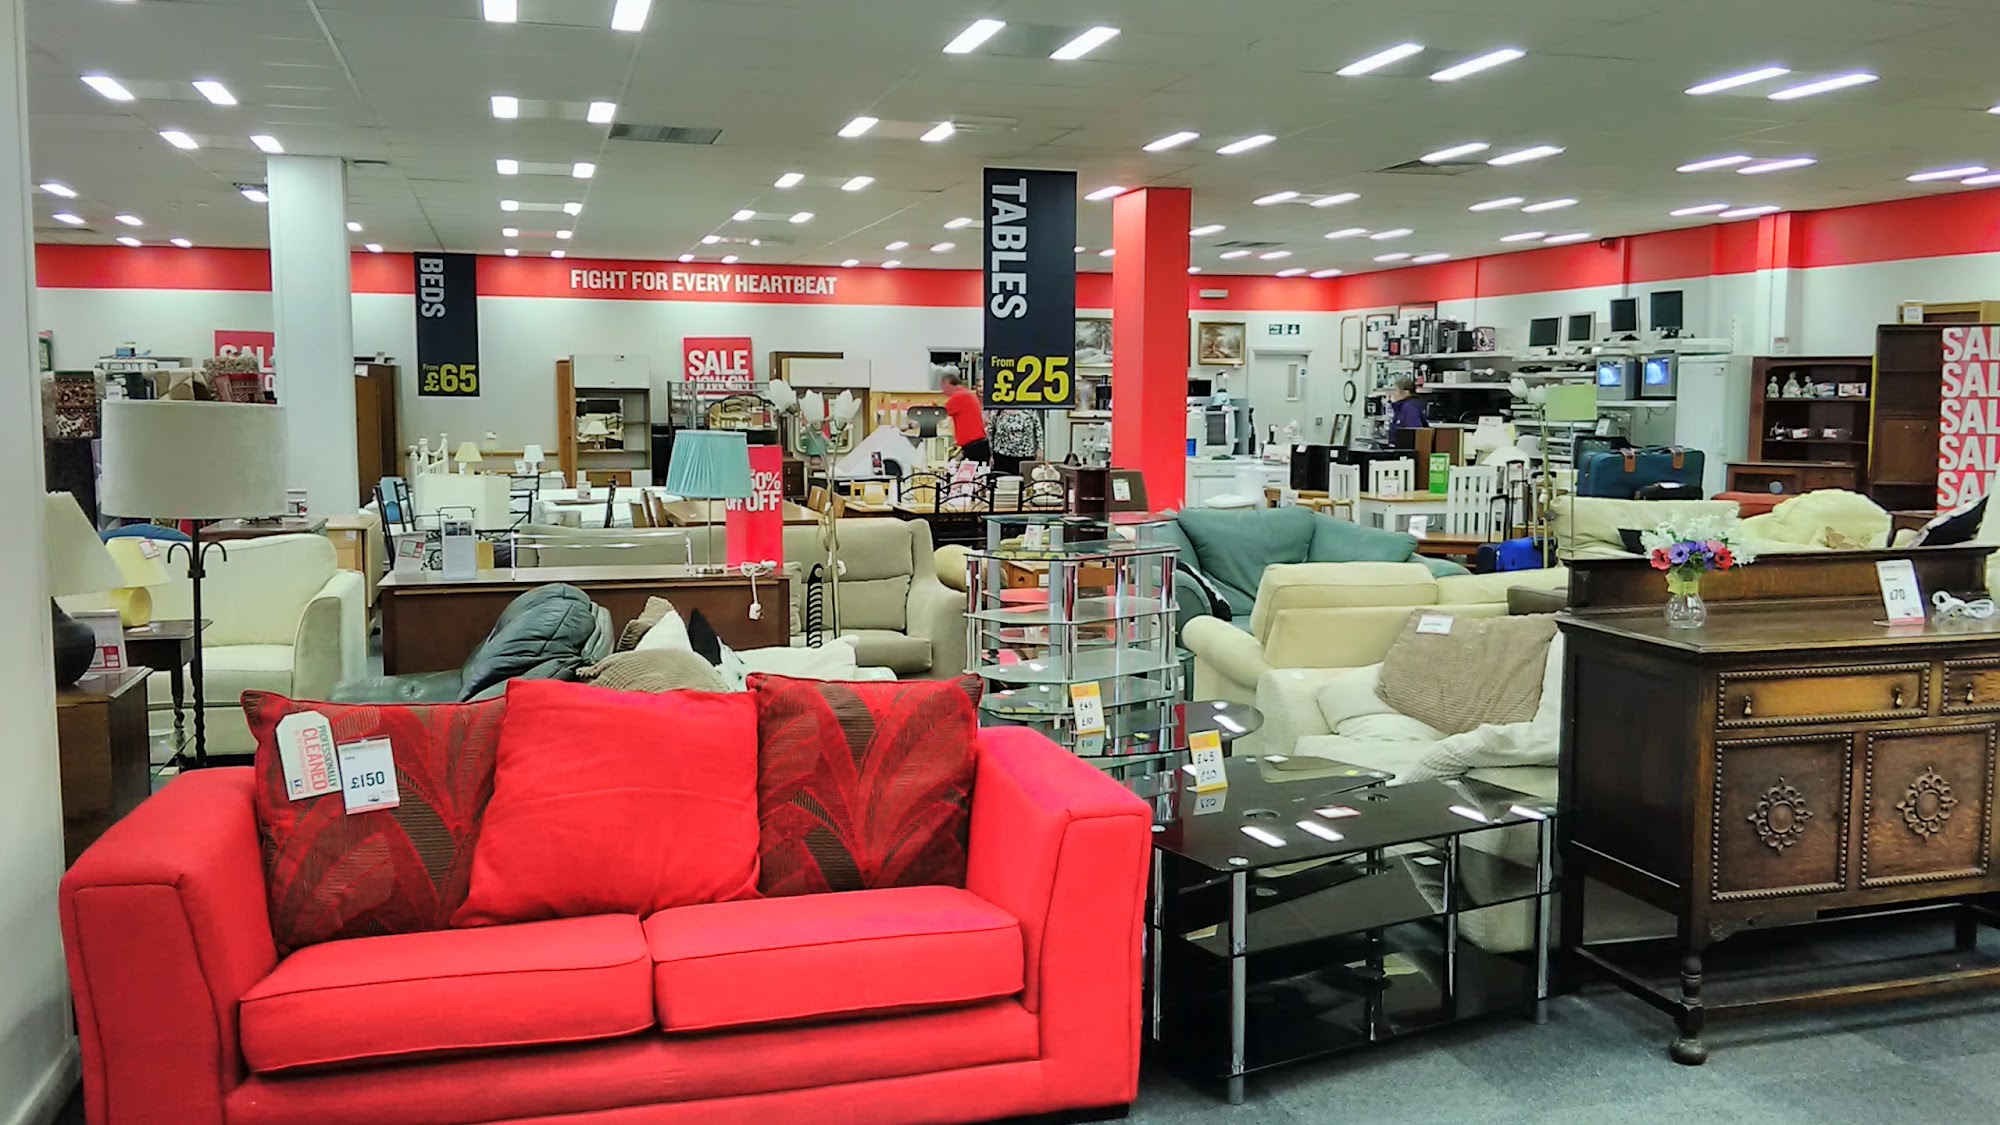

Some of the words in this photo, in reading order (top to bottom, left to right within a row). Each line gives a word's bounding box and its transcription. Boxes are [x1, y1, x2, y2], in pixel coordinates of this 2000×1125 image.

[990, 177, 1028, 319] TABLES
[419, 257, 446, 318] BEDS
[570, 269, 628, 289] FIGHT
[631, 271, 669, 291] FOR
[672, 273, 731, 293] EVERY
[734, 274, 838, 295] HEARTBEAT
[422, 363, 439, 371] From
[688, 349, 749, 376] SALE
[991, 355, 1014, 368] From
[423, 363, 477, 393] £65
[991, 355, 1070, 403] £25
[745, 490, 781, 512] OFF
[302, 727, 328, 791] CLEANED
[318, 725, 337, 788] PROFESSIONALLY
[351, 771, 385, 790] £150
